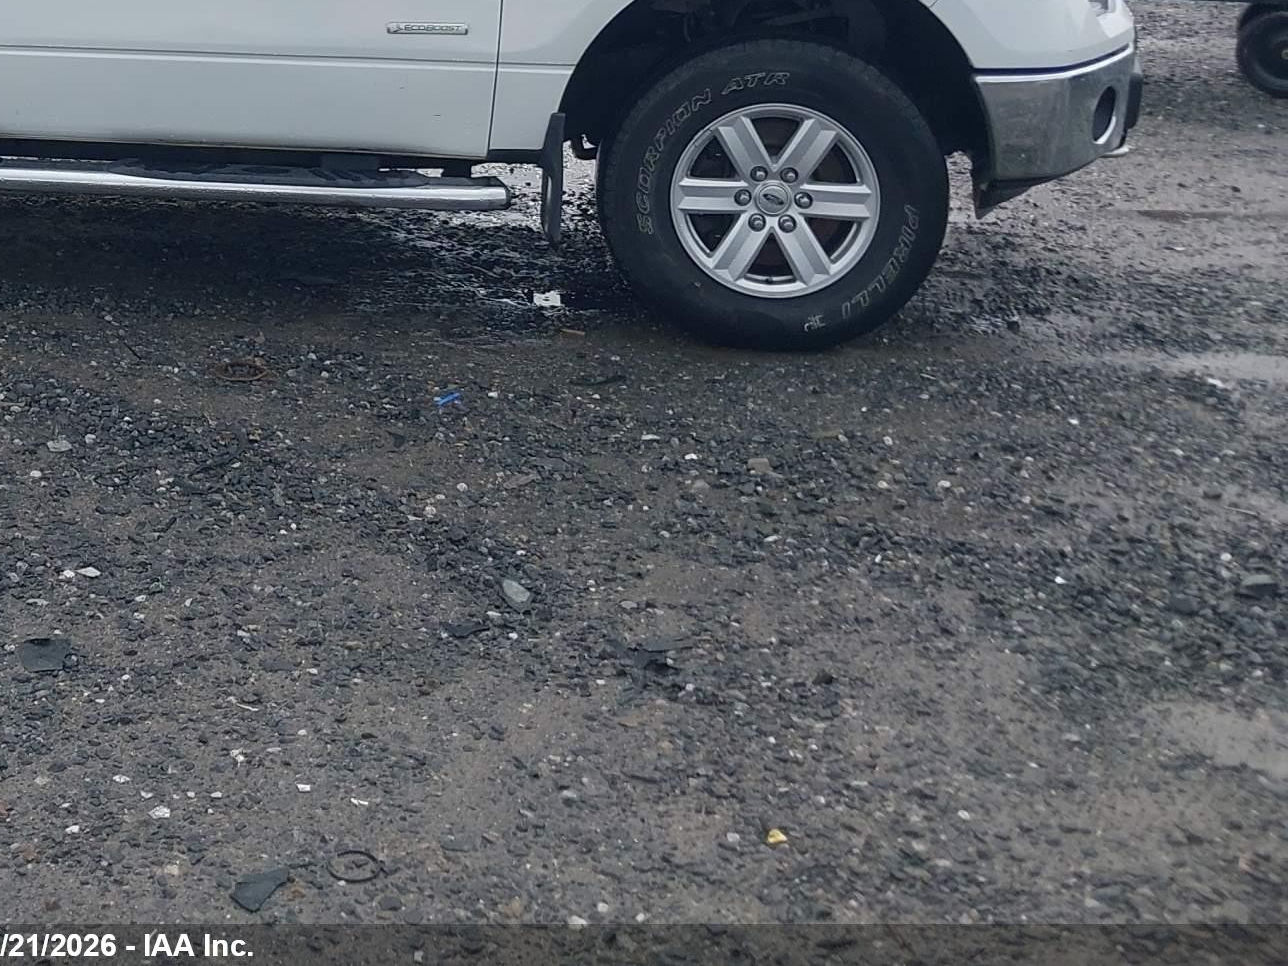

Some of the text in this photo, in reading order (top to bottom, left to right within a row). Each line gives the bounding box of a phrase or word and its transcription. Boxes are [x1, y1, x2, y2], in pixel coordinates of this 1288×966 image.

[635, 72, 791, 235] SCORPION ATR
[840, 203, 920, 319] PIRELLI
